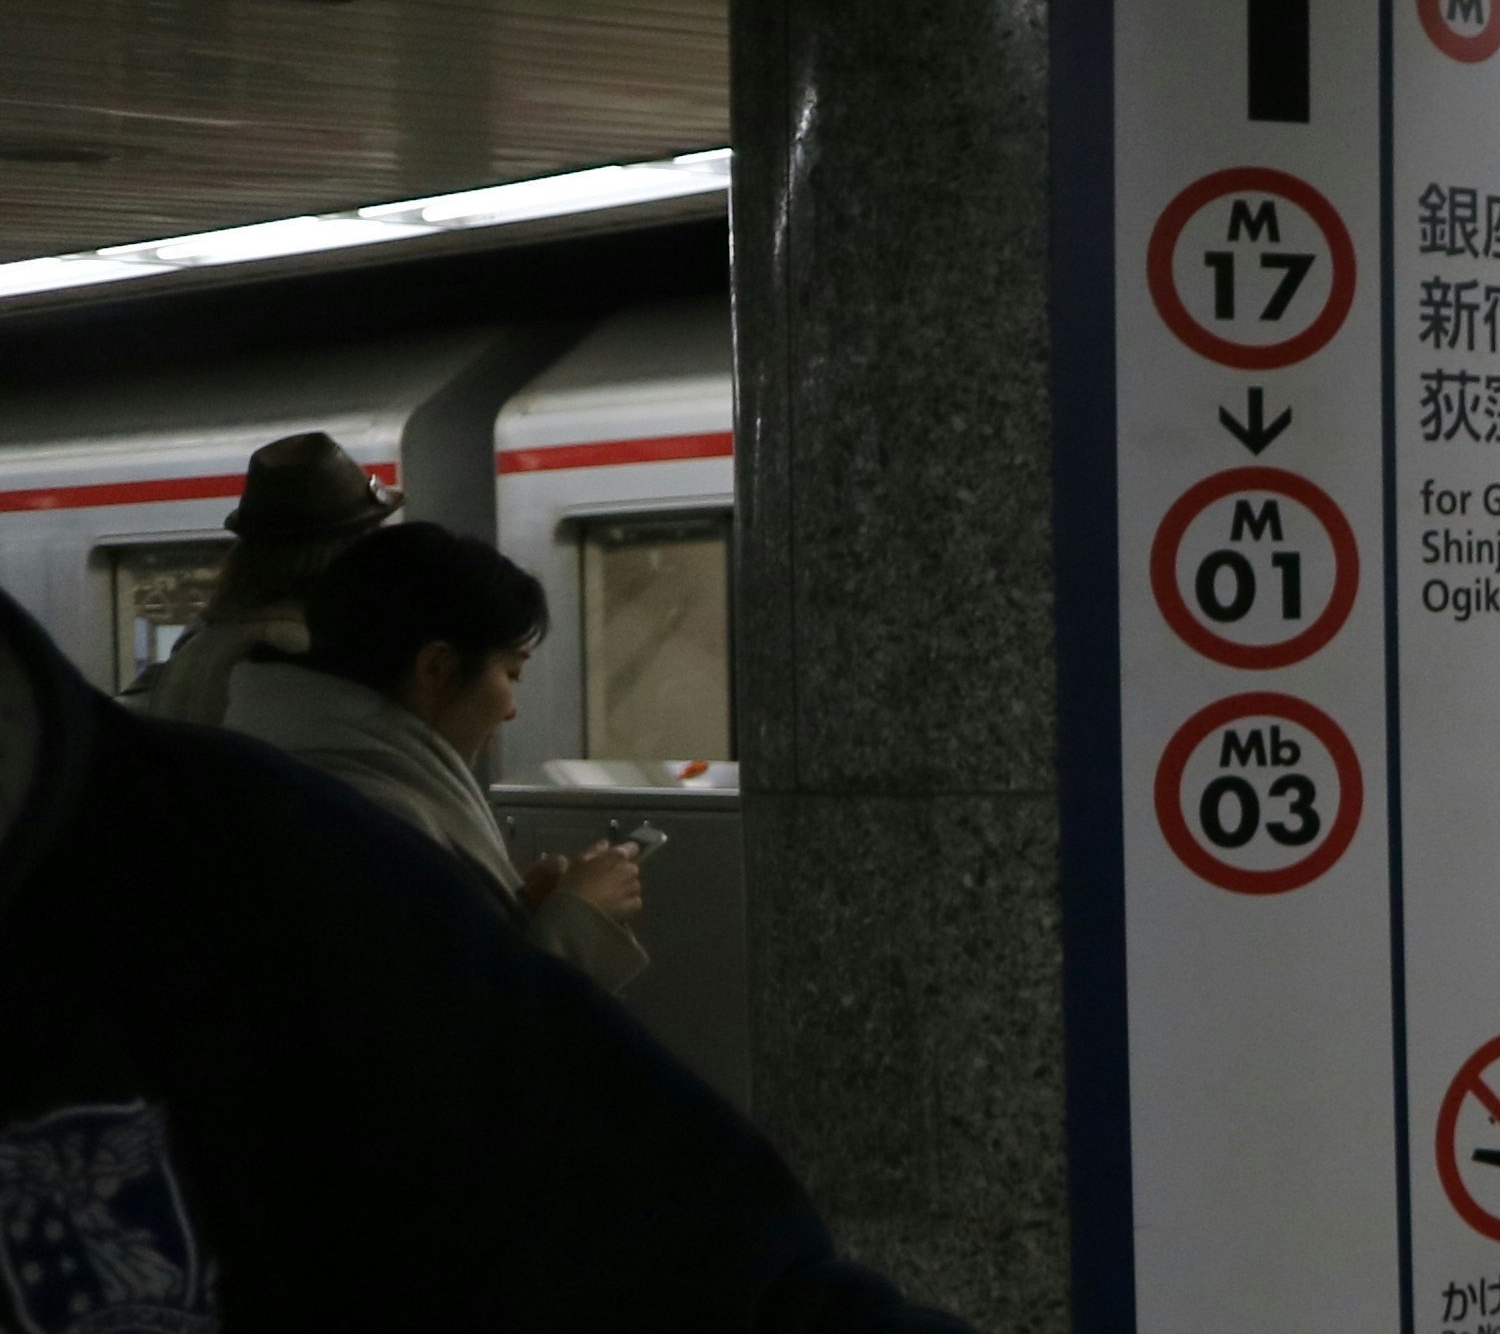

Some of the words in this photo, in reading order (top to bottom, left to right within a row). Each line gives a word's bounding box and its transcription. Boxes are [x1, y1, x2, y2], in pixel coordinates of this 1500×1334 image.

[1227, 200, 1281, 243] M
[1204, 251, 1317, 322] 17
[1420, 480, 1472, 516] for
[1230, 499, 1284, 542] M
[1195, 549, 1302, 622] 01
[1219, 726, 1302, 768] Mb
[1200, 773, 1321, 848] 03
